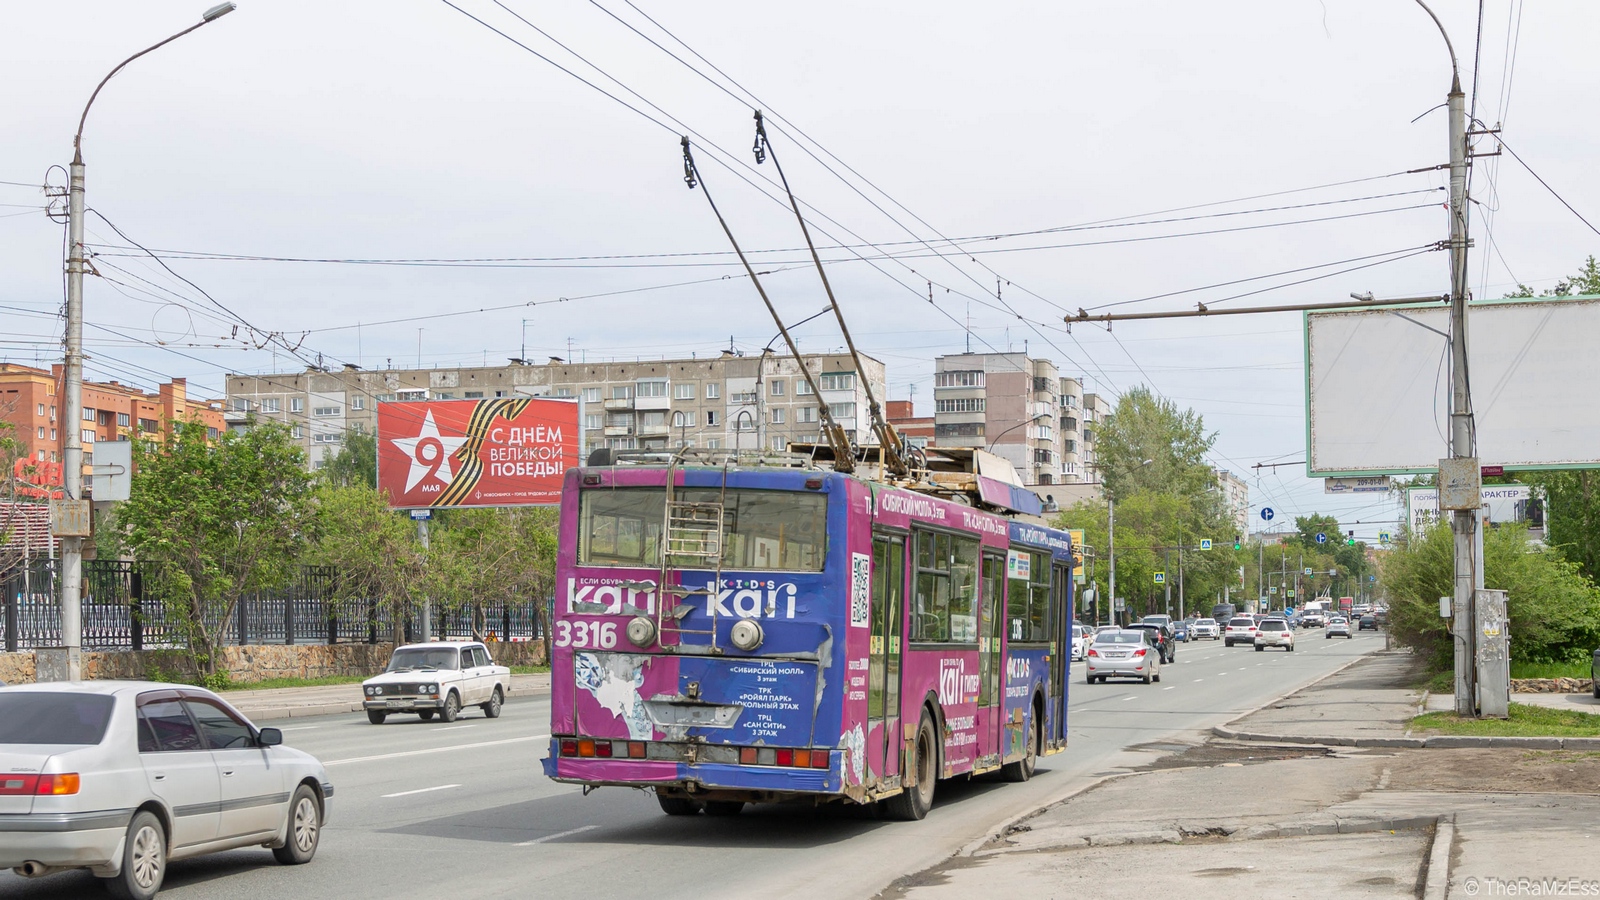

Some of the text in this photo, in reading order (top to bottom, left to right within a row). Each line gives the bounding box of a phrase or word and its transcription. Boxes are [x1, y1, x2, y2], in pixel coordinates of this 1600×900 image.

[491, 424, 563, 447] С ДНЁМ
[414, 436, 445, 477] 9
[490, 443, 563, 462] ВЕЛИКОЙ
[490, 461, 564, 478] ПОБЕДЫ!
[422, 484, 441, 492] МАЯ
[706, 580, 797, 619] kari
[555, 620, 617, 649] 3316
[730, 666, 804, 675] «СИБИРСКИЙ МОЛЛ»
[939, 658, 964, 705] kari
[964, 674, 979, 693] ГИПЕР
[739, 693, 768, 701] «РОЙЯЛ
[758, 714, 772, 722] ТРЦ
[757, 729, 778, 737] ЭТАЖ
